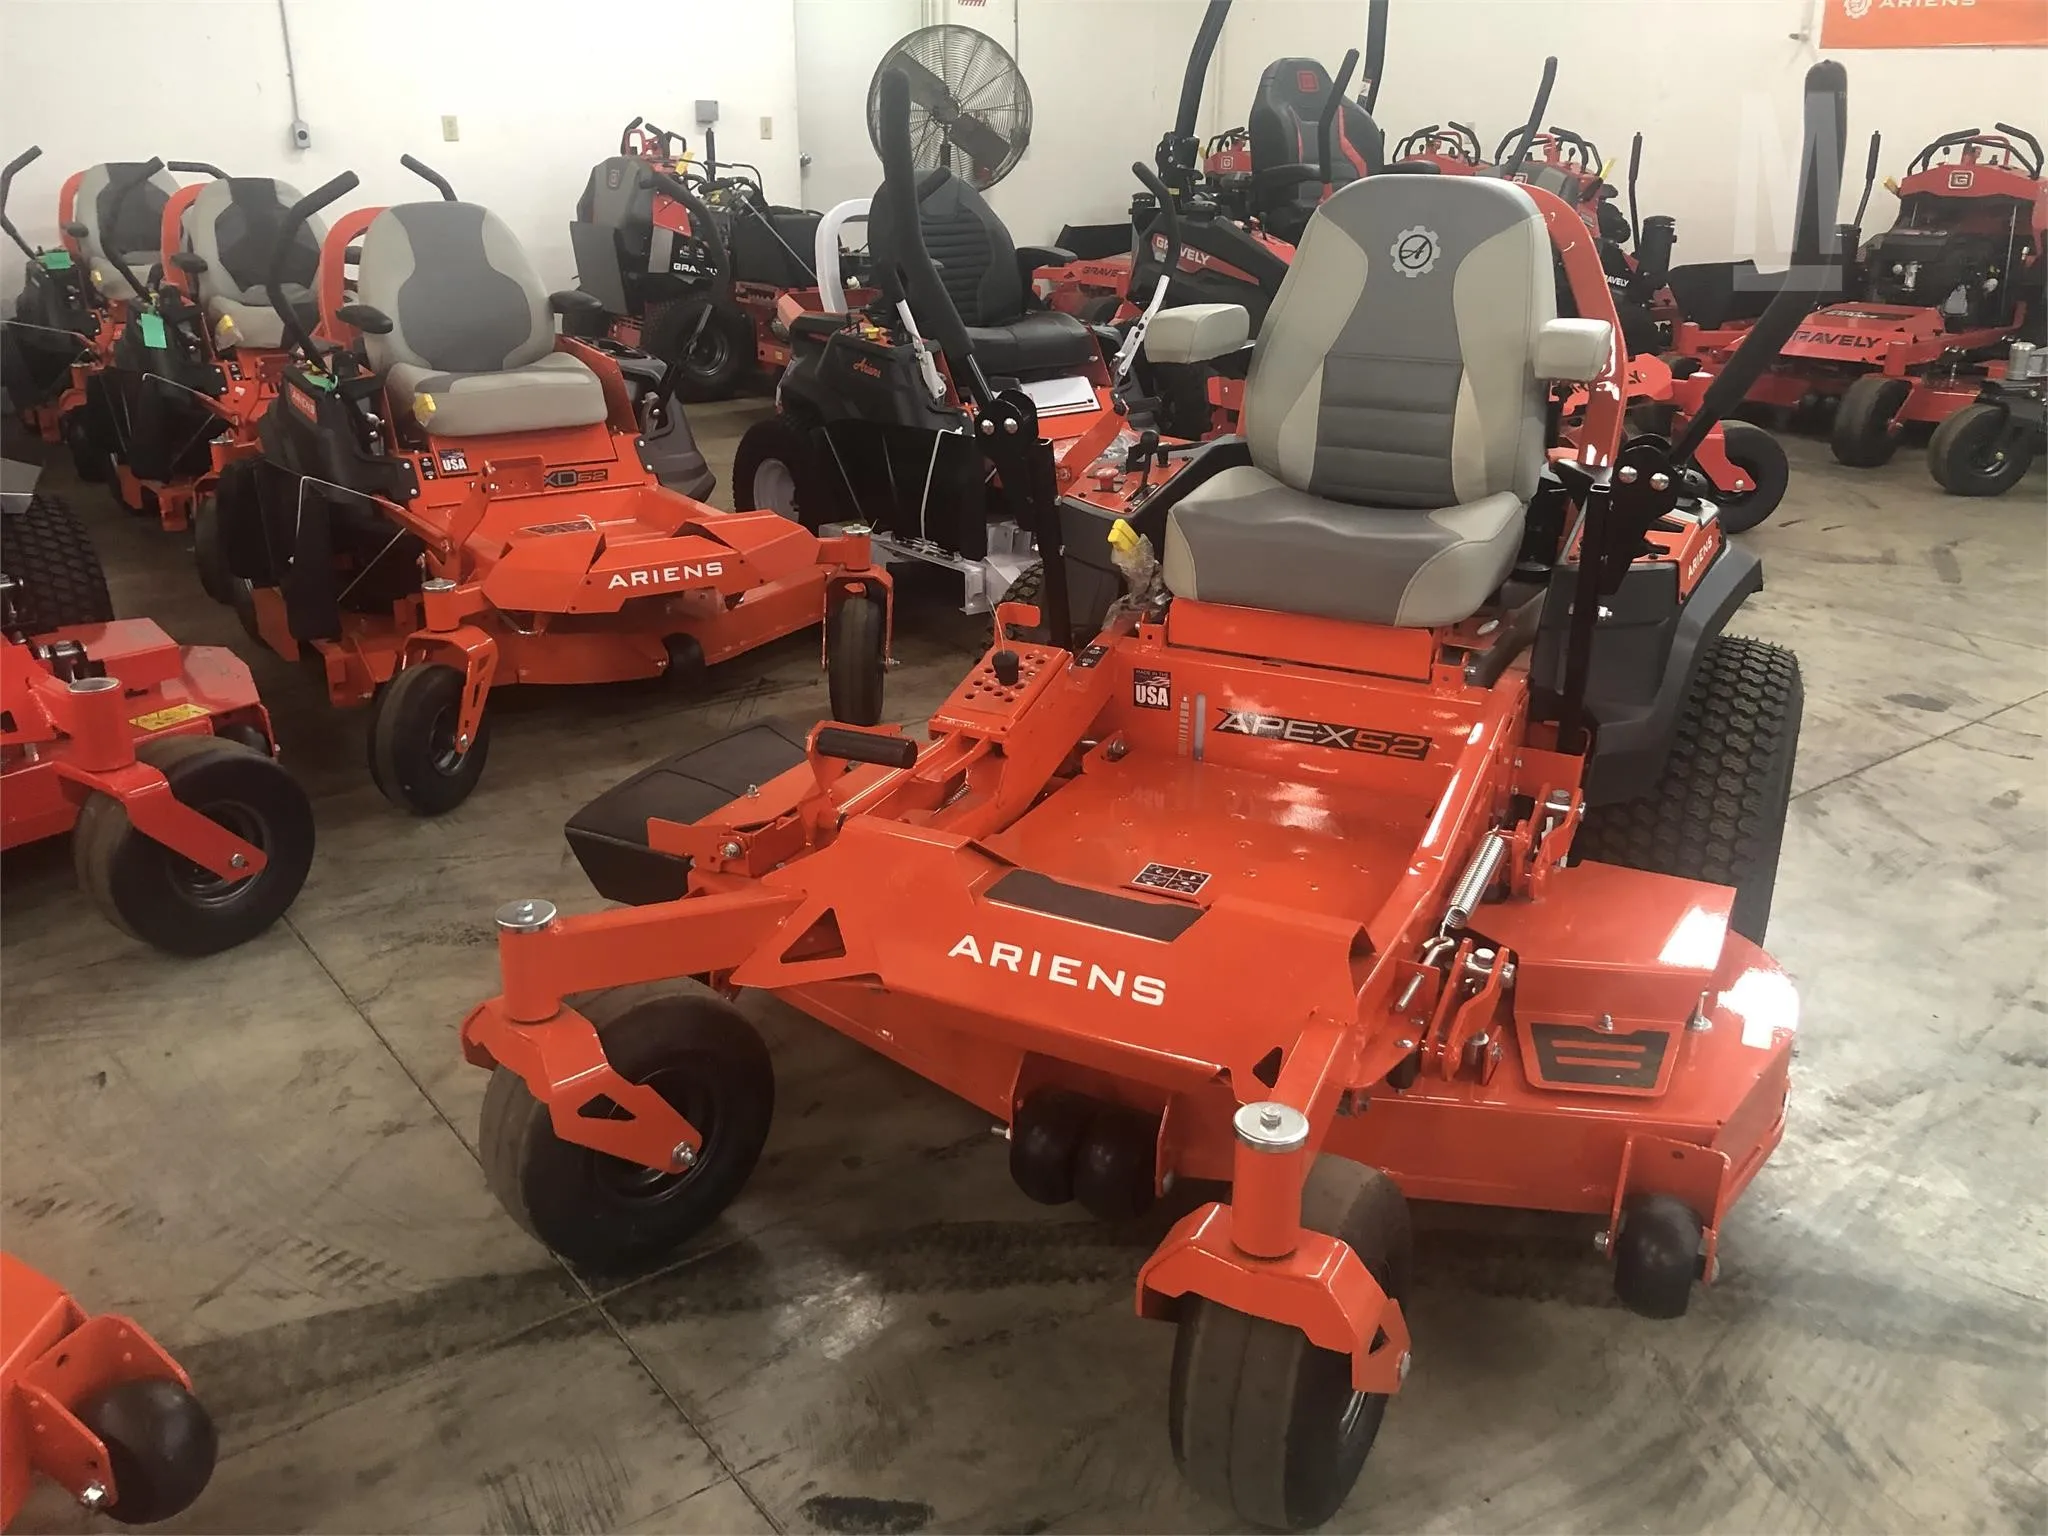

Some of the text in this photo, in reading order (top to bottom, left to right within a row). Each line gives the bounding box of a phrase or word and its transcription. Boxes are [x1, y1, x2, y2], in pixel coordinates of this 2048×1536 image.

[1156, 236, 1211, 266] GVELY
[1082, 265, 1120, 278] GRAVE
[442, 458, 468, 472] USA
[1687, 535, 1713, 580] ARIENS
[608, 561, 723, 589] ARIENS
[1135, 684, 1169, 706] USA
[947, 934, 1167, 1006] ARIENS
